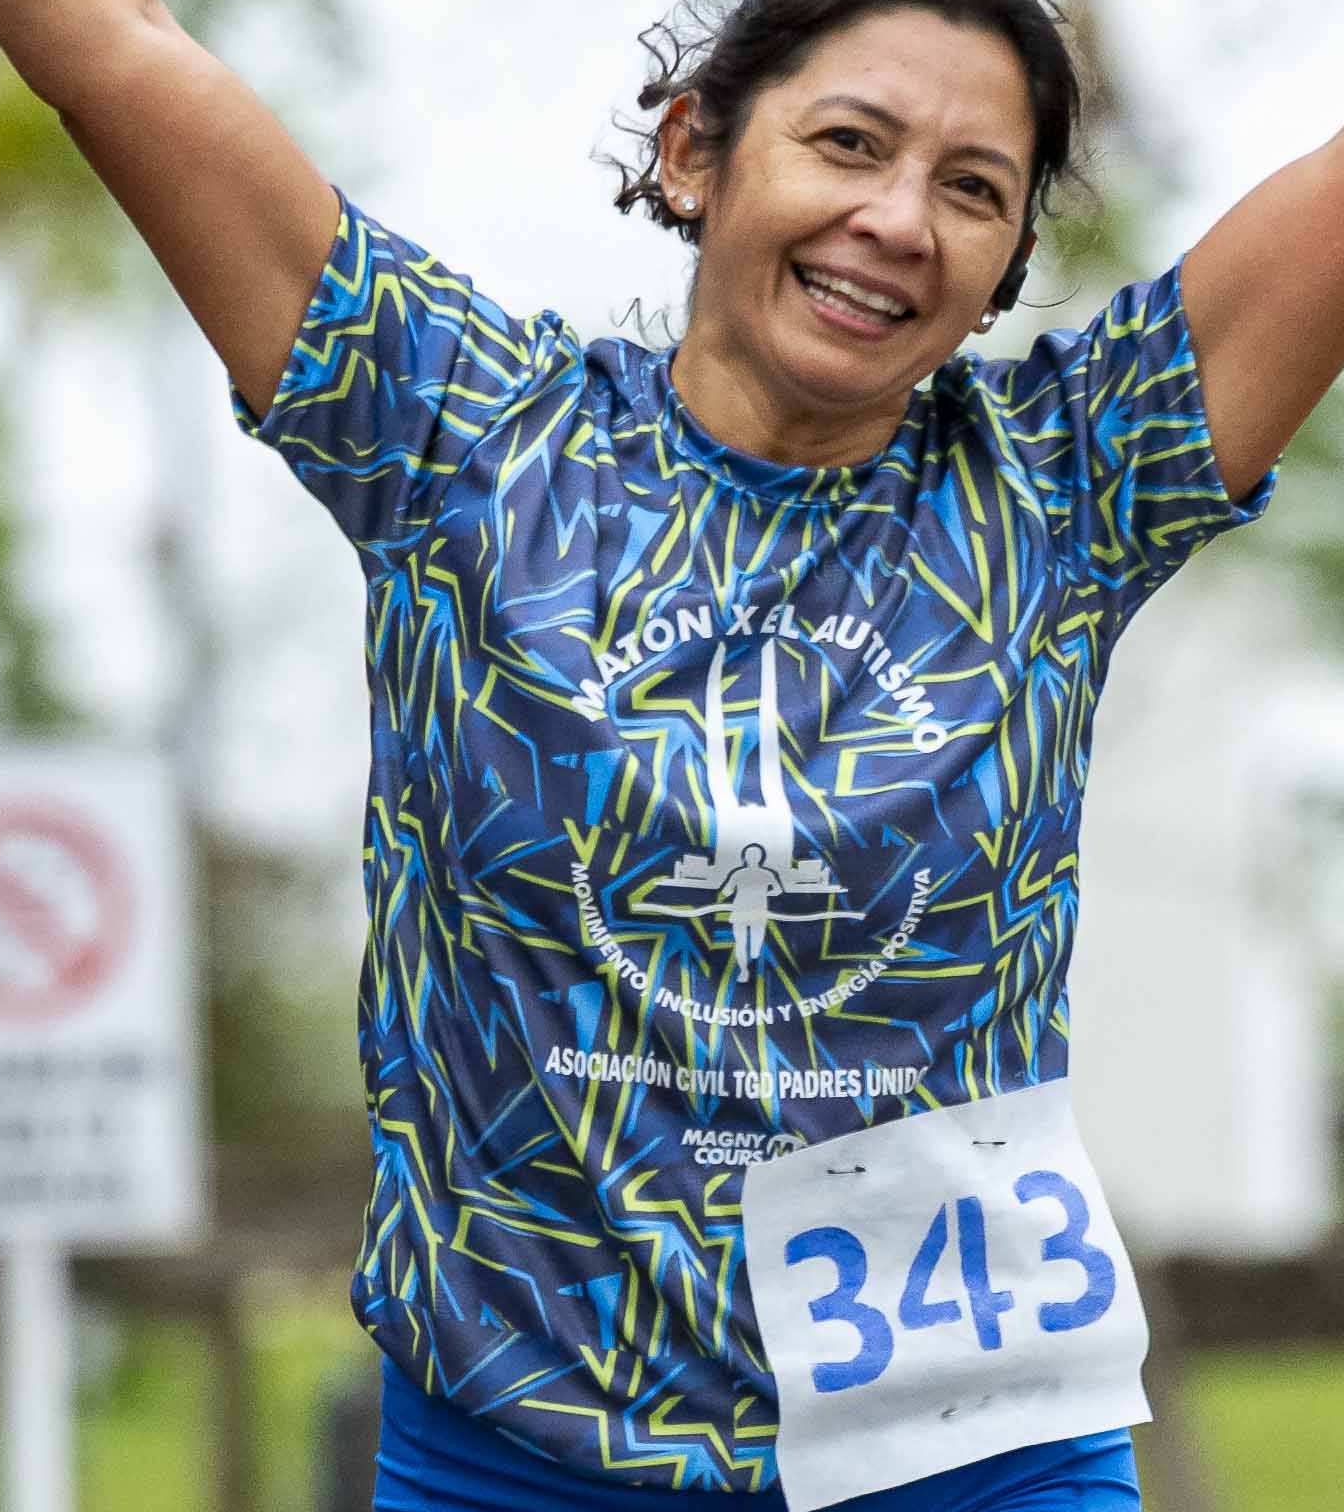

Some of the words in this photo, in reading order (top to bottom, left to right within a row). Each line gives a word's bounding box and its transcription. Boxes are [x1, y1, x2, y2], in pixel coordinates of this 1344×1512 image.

[572, 605, 713, 723] MATÓN
[725, 603, 759, 636] X
[760, 602, 800, 639] EL
[809, 615, 948, 753] AUTISMO
[570, 862, 649, 997] MOVIMIENTO,
[654, 987, 774, 1027] INCLUSIÓN
[777, 1004, 793, 1022] Y
[797, 960, 888, 1018] ENERGÍA
[881, 867, 932, 961] POSITIVA
[544, 1045, 672, 1089] ASOCIACIÓN
[675, 1066, 730, 1097] CIVIL
[732, 1070, 775, 1100] TGD
[778, 1068, 862, 1099] PADRES
[680, 1129, 766, 1149] MAGNY
[694, 1148, 764, 1166] COURS
[783, 1169, 1117, 1394] 343
